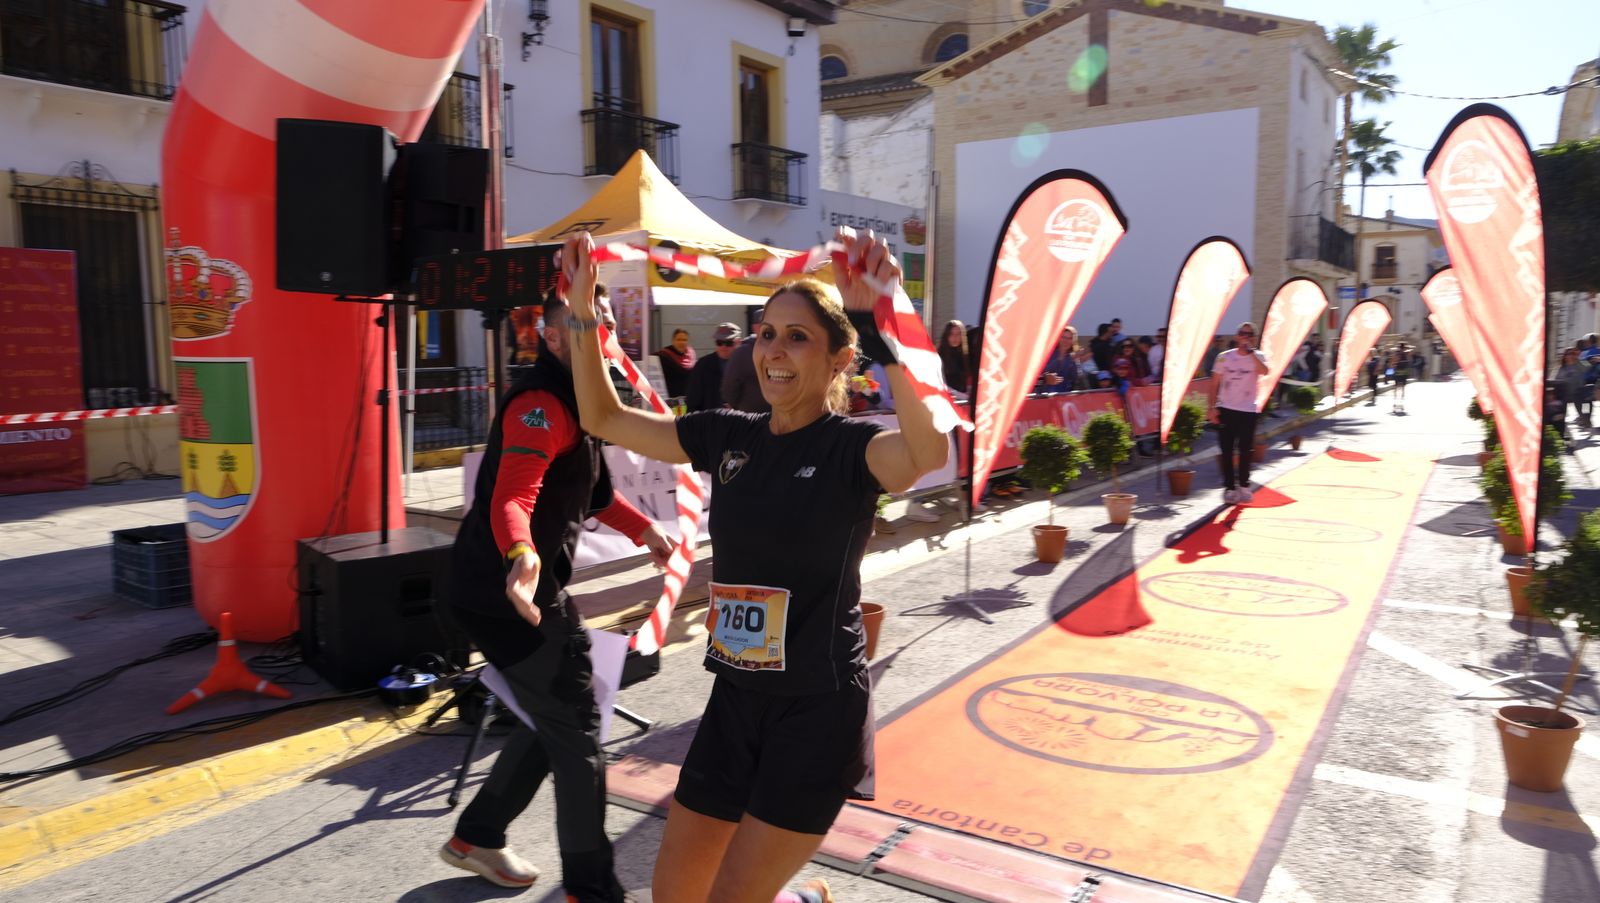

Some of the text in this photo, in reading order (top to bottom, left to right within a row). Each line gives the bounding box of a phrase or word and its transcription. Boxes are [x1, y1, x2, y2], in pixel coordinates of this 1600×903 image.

[721, 603, 765, 633] 160
[891, 798, 1112, 862] de Cantoria
